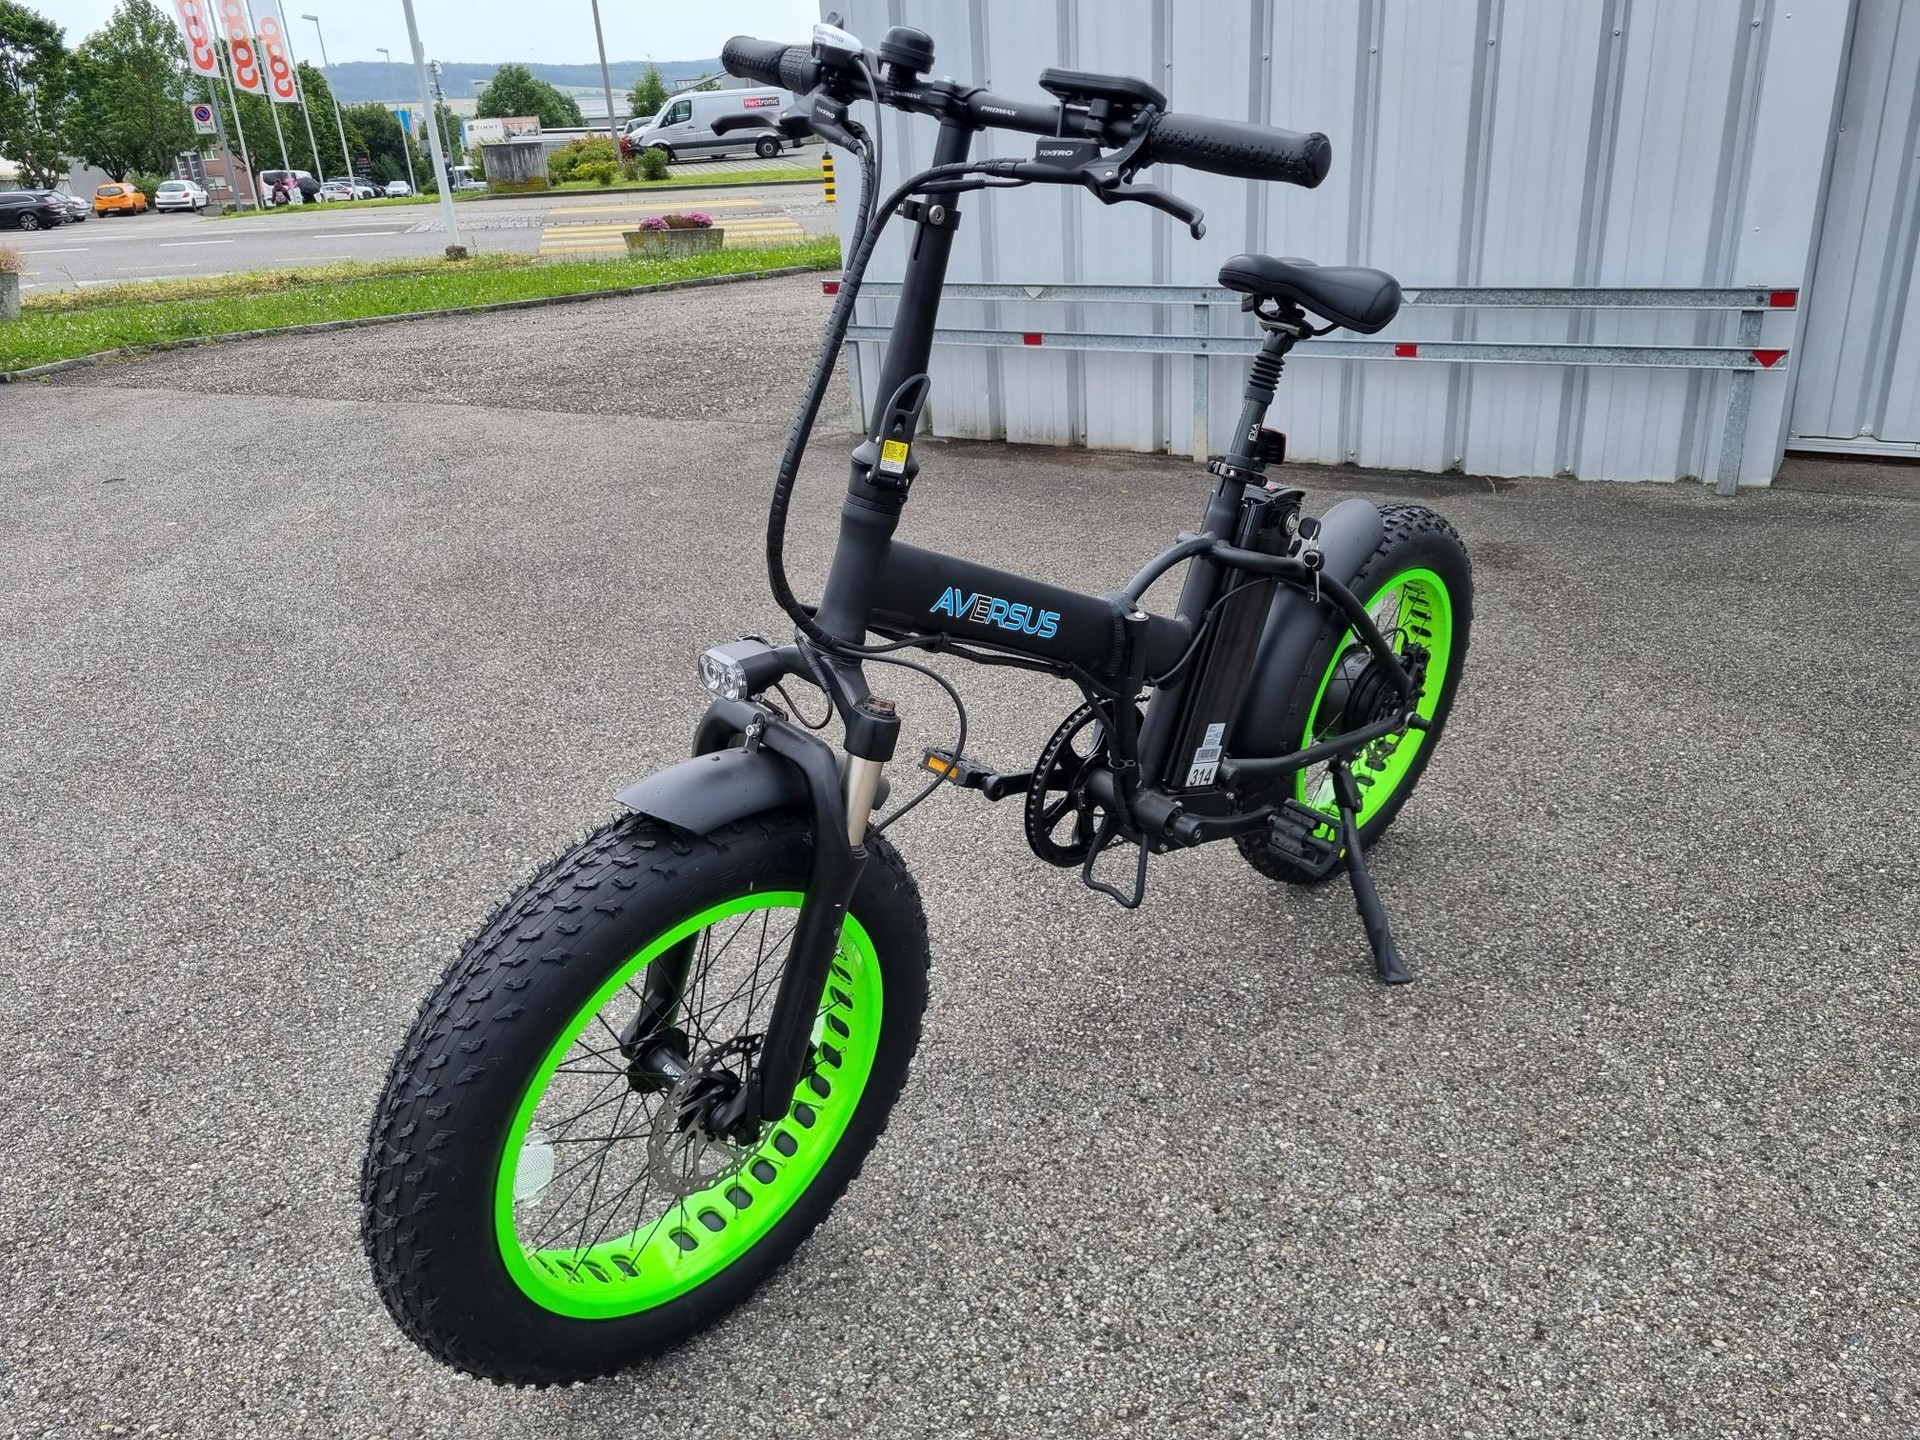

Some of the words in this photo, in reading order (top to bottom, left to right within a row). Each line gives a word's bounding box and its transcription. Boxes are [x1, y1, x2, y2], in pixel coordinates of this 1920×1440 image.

[744, 98, 779, 108] Hectronic
[815, 106, 836, 119] TEKTRO
[980, 105, 1018, 116] PROMAX
[1039, 149, 1074, 157] TEKTRO
[1247, 423, 1260, 442] EXA
[929, 586, 1061, 638] AVERSUS
[1189, 767, 1213, 786] 314
